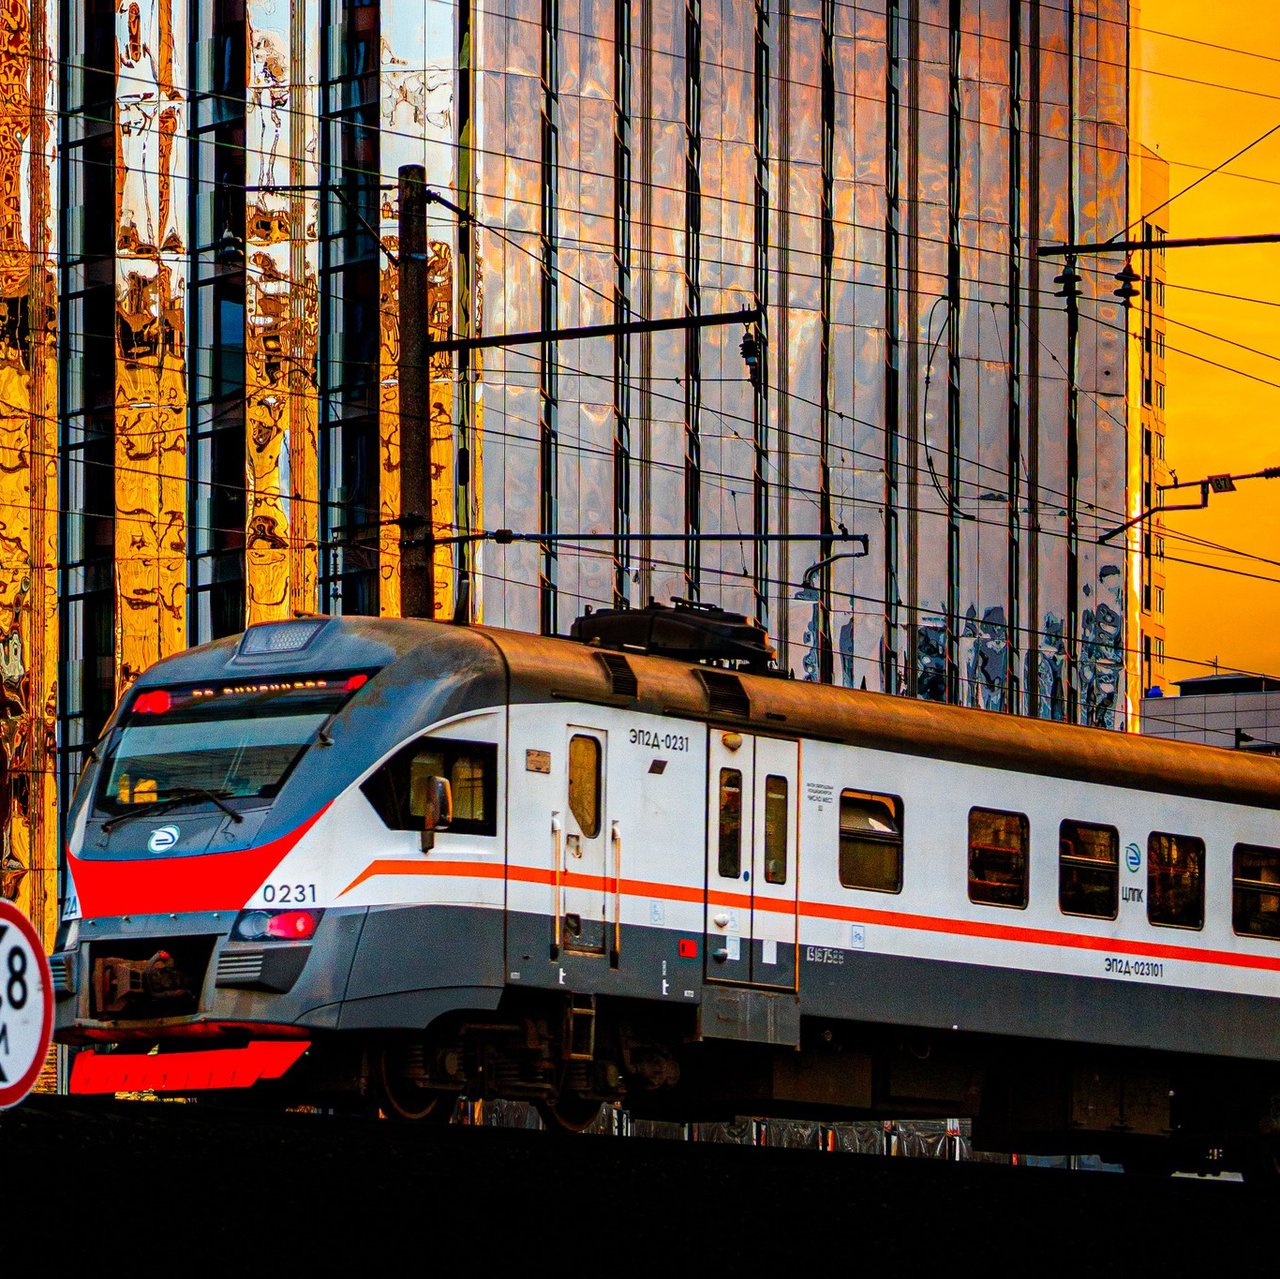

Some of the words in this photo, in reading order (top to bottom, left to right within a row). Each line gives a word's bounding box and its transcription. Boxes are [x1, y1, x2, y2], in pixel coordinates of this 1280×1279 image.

[629, 728, 689, 752] ЭП2Д-0231
[263, 884, 316, 903] 0231
[1104, 957, 1164, 978] ЭП2Д-023101
